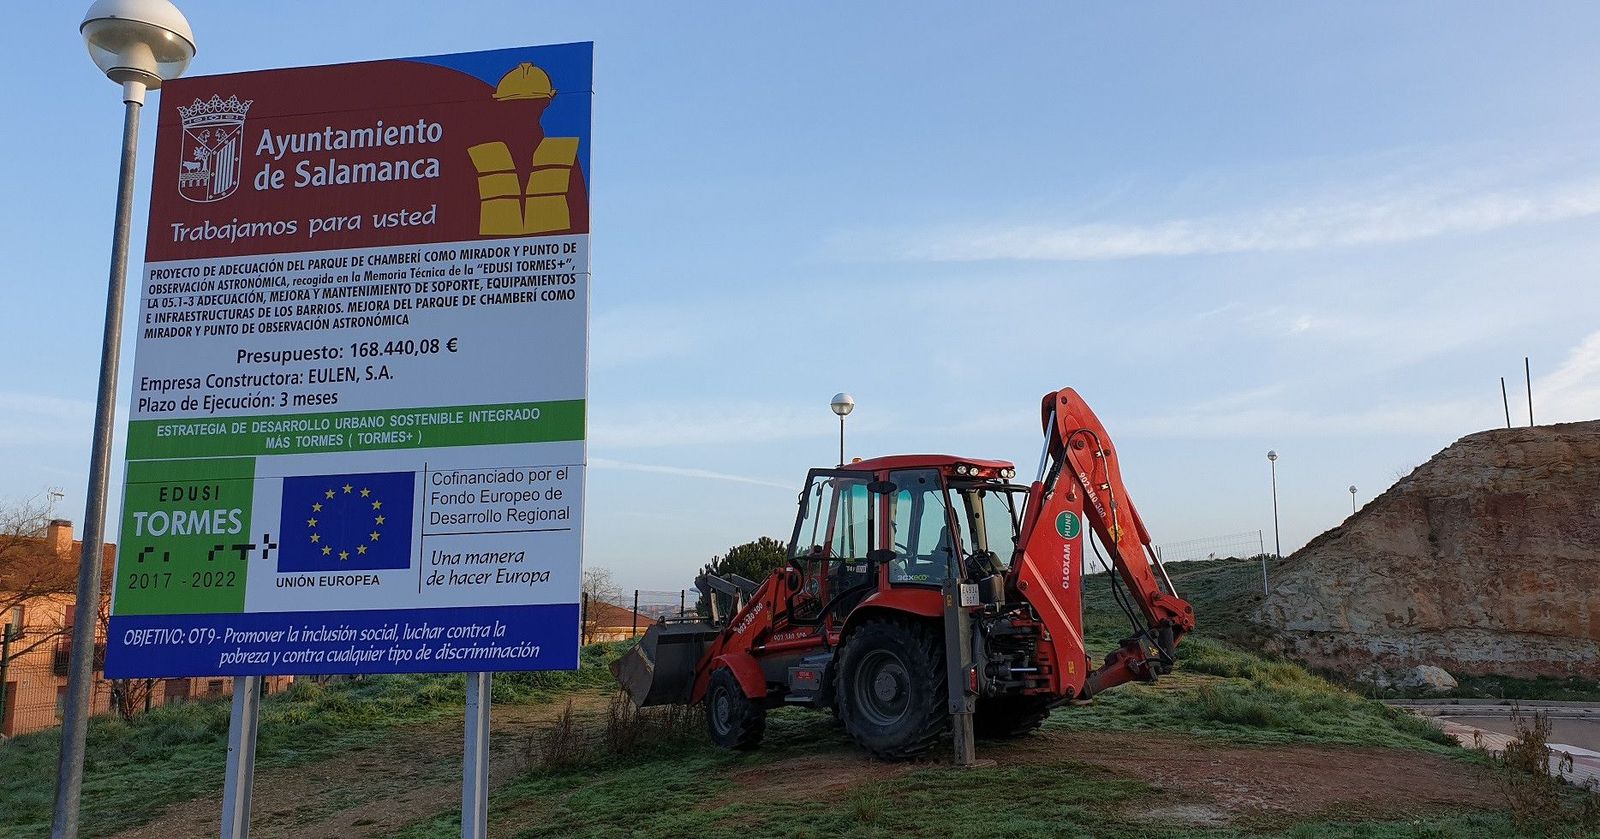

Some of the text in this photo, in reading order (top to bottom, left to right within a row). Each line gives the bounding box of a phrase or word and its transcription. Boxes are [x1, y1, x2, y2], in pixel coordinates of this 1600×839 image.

[256, 119, 442, 160] Ayuntamiento
[254, 158, 439, 190] de Salamanca
[171, 204, 436, 243] Trabajamos para usted
[150, 242, 576, 280] PROYECTO DE ADECUACIÓN DEL PARQUE DE CHAMBERÍ COMO MIRADOR Y PUNTO DE
[147, 273, 576, 309] LA 05.1-3 ADECUACIÓN, MEJORA Y MANTENIMIENTO DE SOPORTE, EQUIPAMIENTOS
[148, 278, 215, 295] OBSERVACIÓN
[217, 274, 289, 292] ASTRONÓMICA,
[293, 273, 333, 287] recogida
[336, 275, 348, 283] en
[351, 271, 360, 282] la
[364, 269, 406, 281] Memoria
[410, 267, 445, 278] Técnica
[449, 264, 461, 276] de
[464, 264, 473, 275] la
[146, 287, 575, 324] E INFRAESTRUCTURAS DE LOS BARRIOS. MEJORA DEL PARQUE DE CHAMBERÍ COMO
[144, 312, 409, 339] MIRADOR Y PUNTO DE OBSERVACIÓN ASTRONÓMICA
[237, 337, 458, 366] Presupuesto: 168.440,08 €
[141, 365, 393, 394] Empresa Constructora: EULEN, S.A.
[138, 391, 338, 414] Plazo de Ejecución: 3 meses
[157, 408, 540, 436] ESTRATEGIA DE DESARROLLO URBANO SOSTENIBLE INTEGRADO
[266, 435, 290, 448] MÁS
[295, 434, 343, 447] TORMES
[357, 431, 413, 444] TORMES+
[432, 466, 568, 485] Cofinanciado por el
[1079, 472, 1090, 487] 902
[159, 485, 219, 502] EDUSI
[431, 487, 562, 505] Fondo Europeo de
[133, 508, 242, 536] TORMES
[430, 506, 569, 525] Desarrollo Regional
[1064, 513, 1072, 537] HUNE
[431, 550, 524, 565] Una manera
[276, 575, 380, 587] UNIÓN EUROPEA
[426, 568, 550, 586] de hacer Europa
[124, 628, 185, 647] OBJETIVO:
[224, 628, 285, 643] Promover
[287, 626, 299, 642] la
[301, 625, 357, 642] inclusión
[359, 623, 398, 642] social,
[403, 622, 445, 640] luchar
[447, 623, 491, 638] contra
[493, 620, 506, 637] la
[219, 641, 540, 668] pobreza y contra cualquier tipo de discriminación
